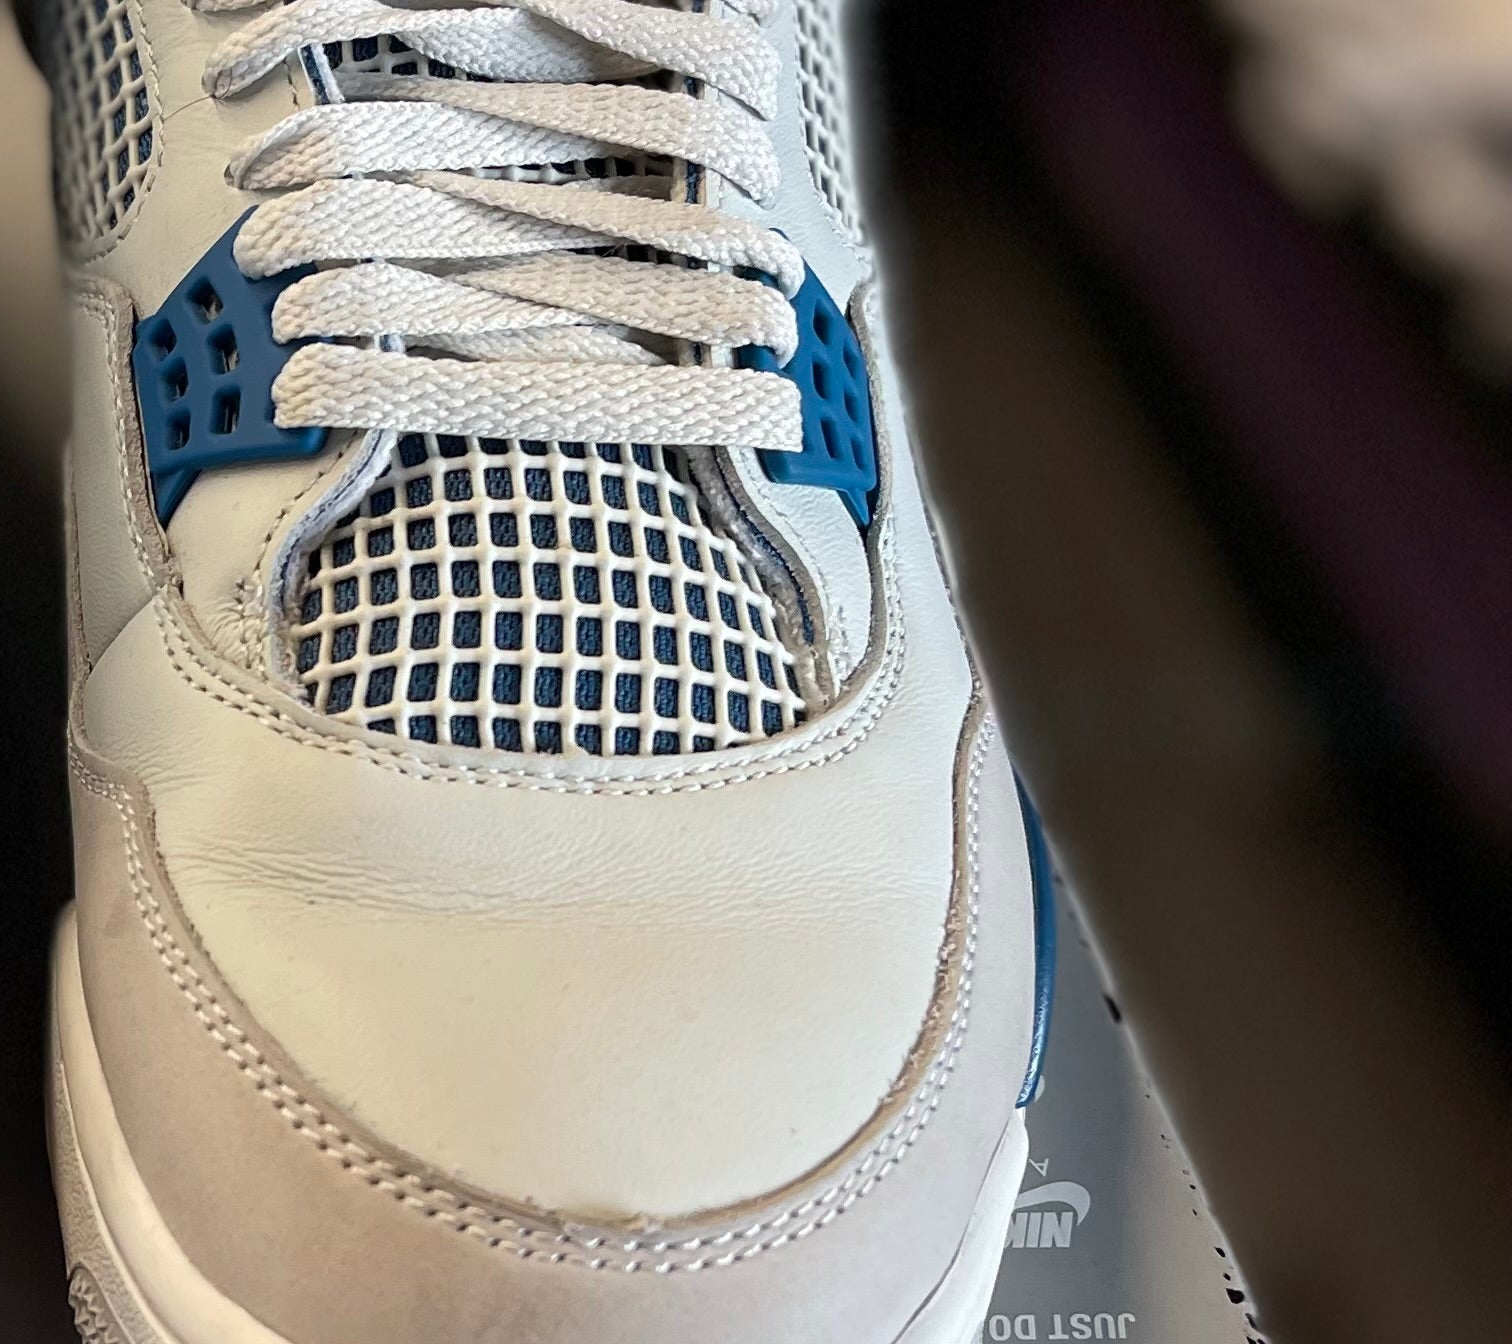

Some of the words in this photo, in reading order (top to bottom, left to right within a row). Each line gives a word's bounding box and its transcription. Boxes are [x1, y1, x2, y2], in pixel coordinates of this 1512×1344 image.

[1004, 1212, 1073, 1248] NIK
[988, 1314, 1036, 1341] DO
[1048, 1312, 1136, 1340] JUST
